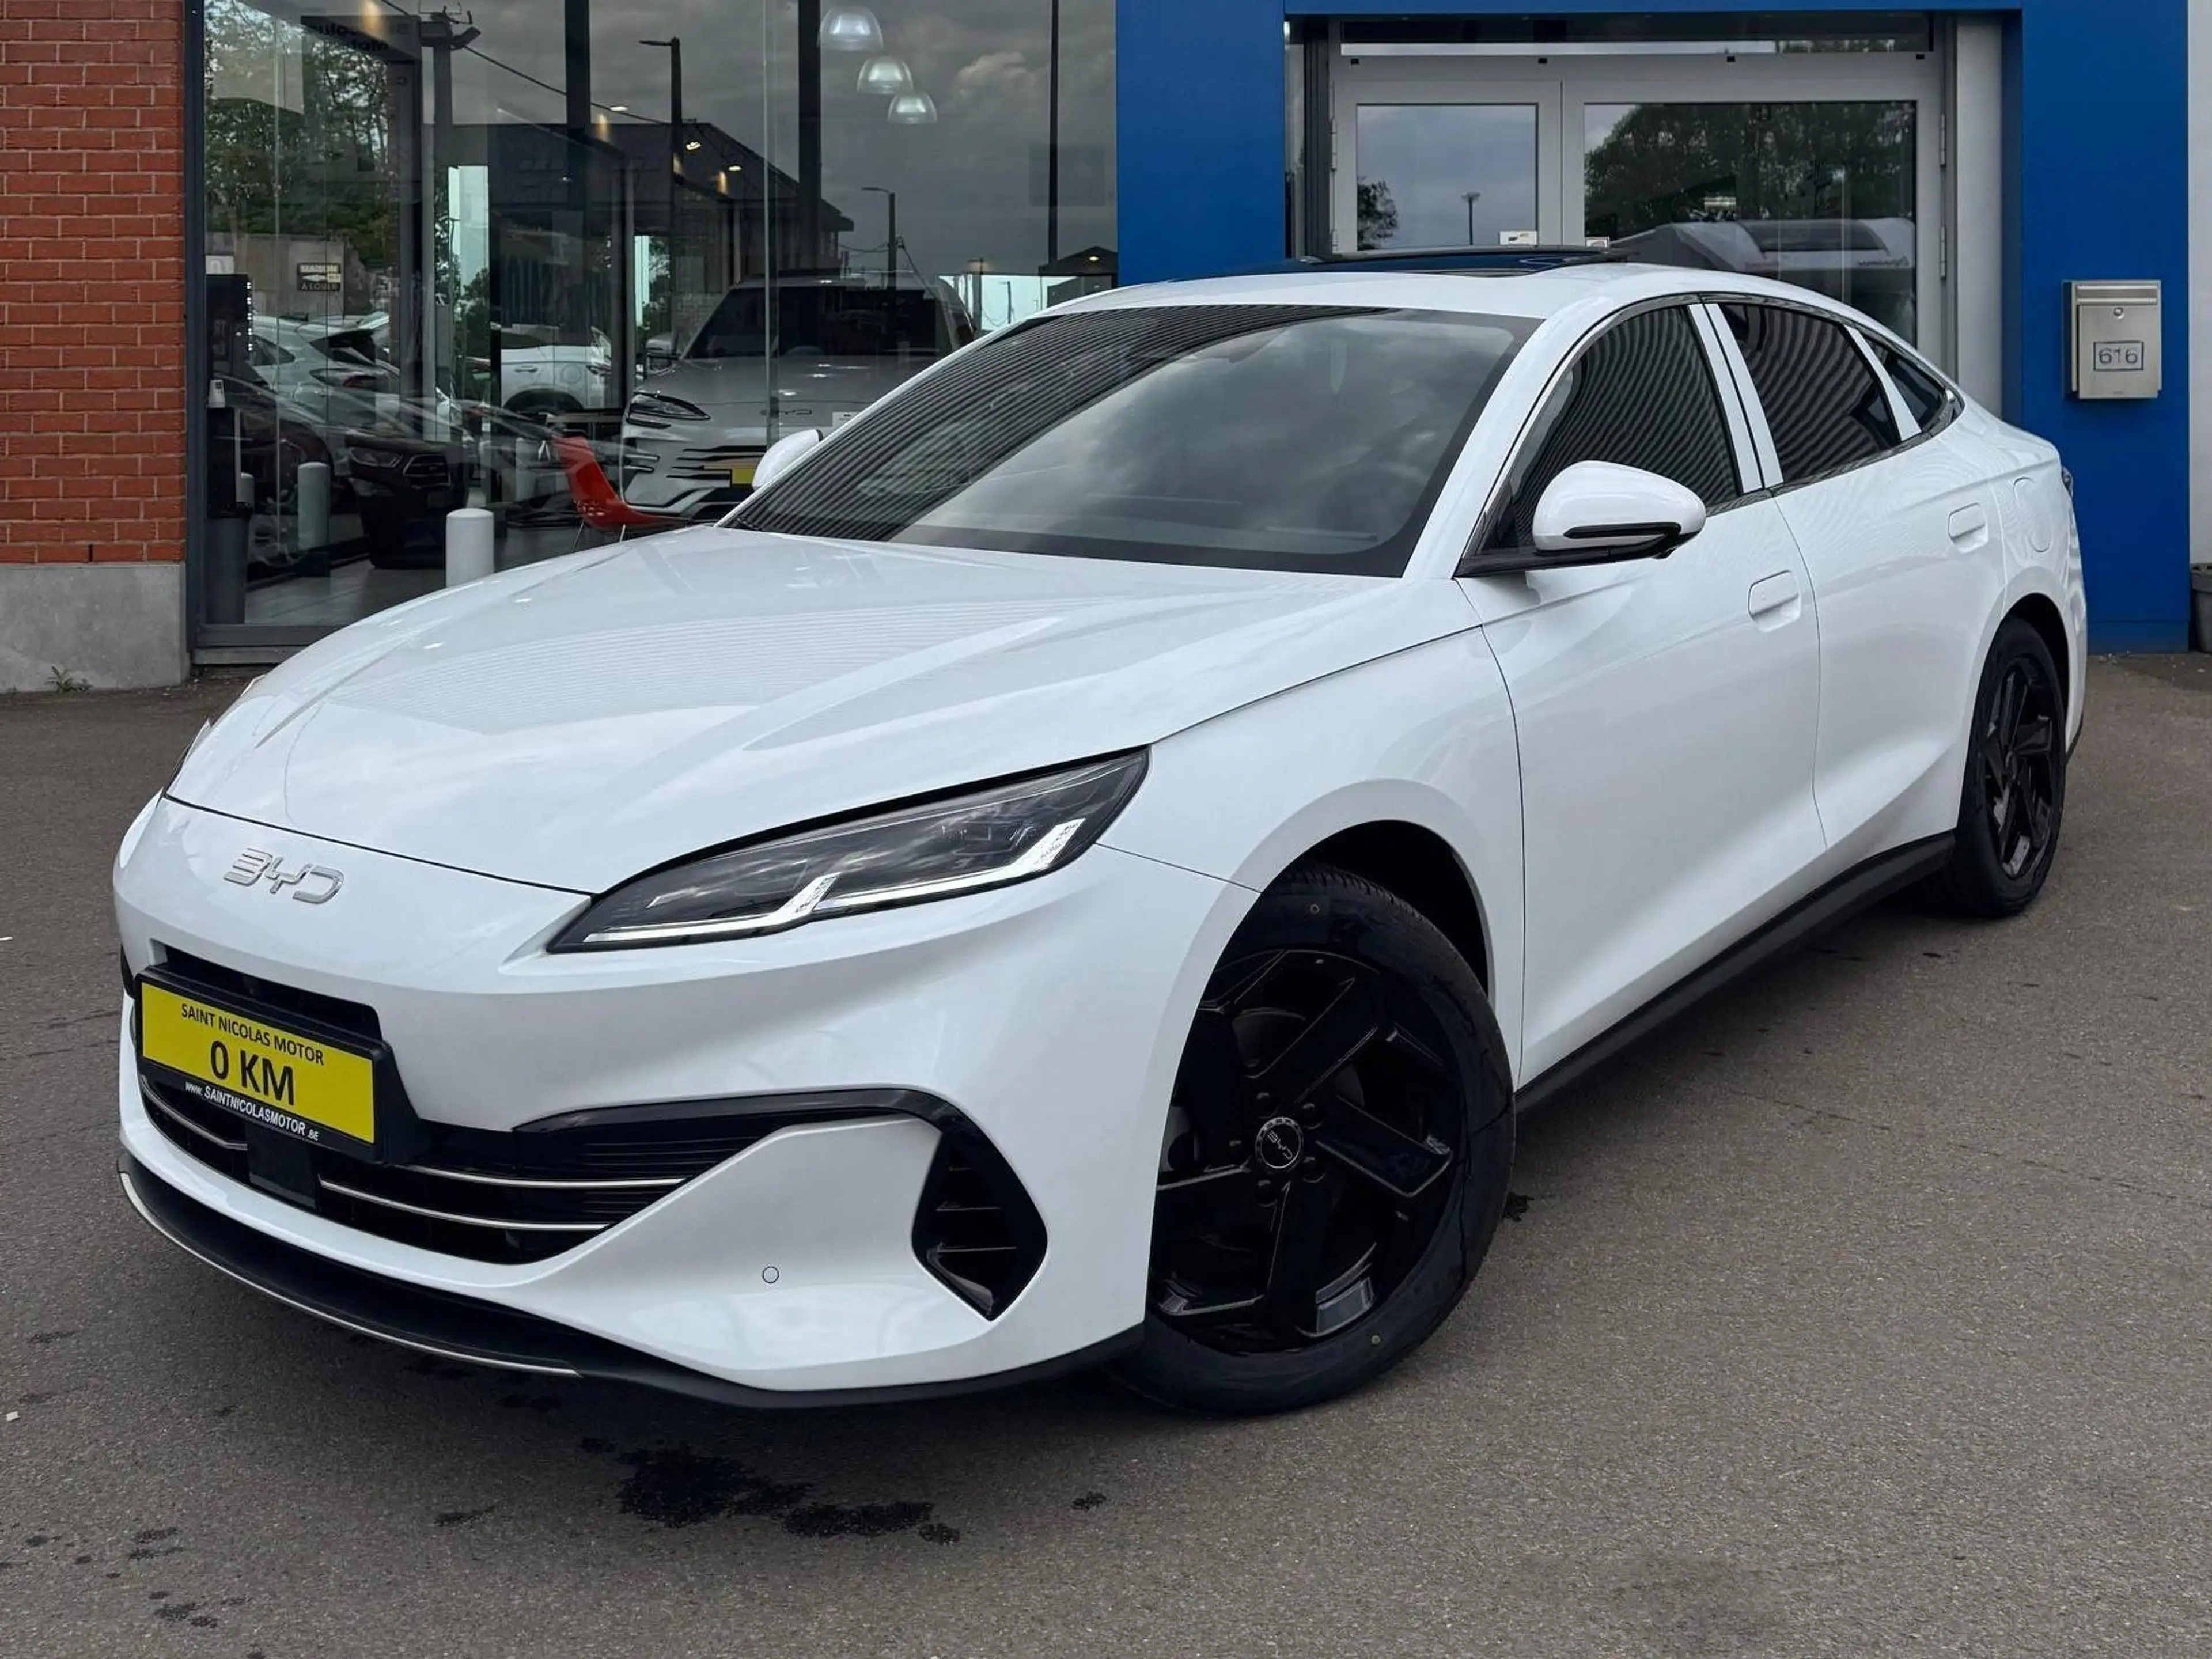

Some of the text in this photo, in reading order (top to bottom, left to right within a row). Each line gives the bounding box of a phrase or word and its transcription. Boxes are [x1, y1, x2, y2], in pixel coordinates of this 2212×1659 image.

[2098, 347, 2138, 364] 616
[223, 847, 344, 904] BYD
[181, 1004, 324, 1065] SAINT NICOLAS MOTOR
[211, 1040, 294, 1105] 0 KM
[1267, 1130, 1293, 1160] BYD
